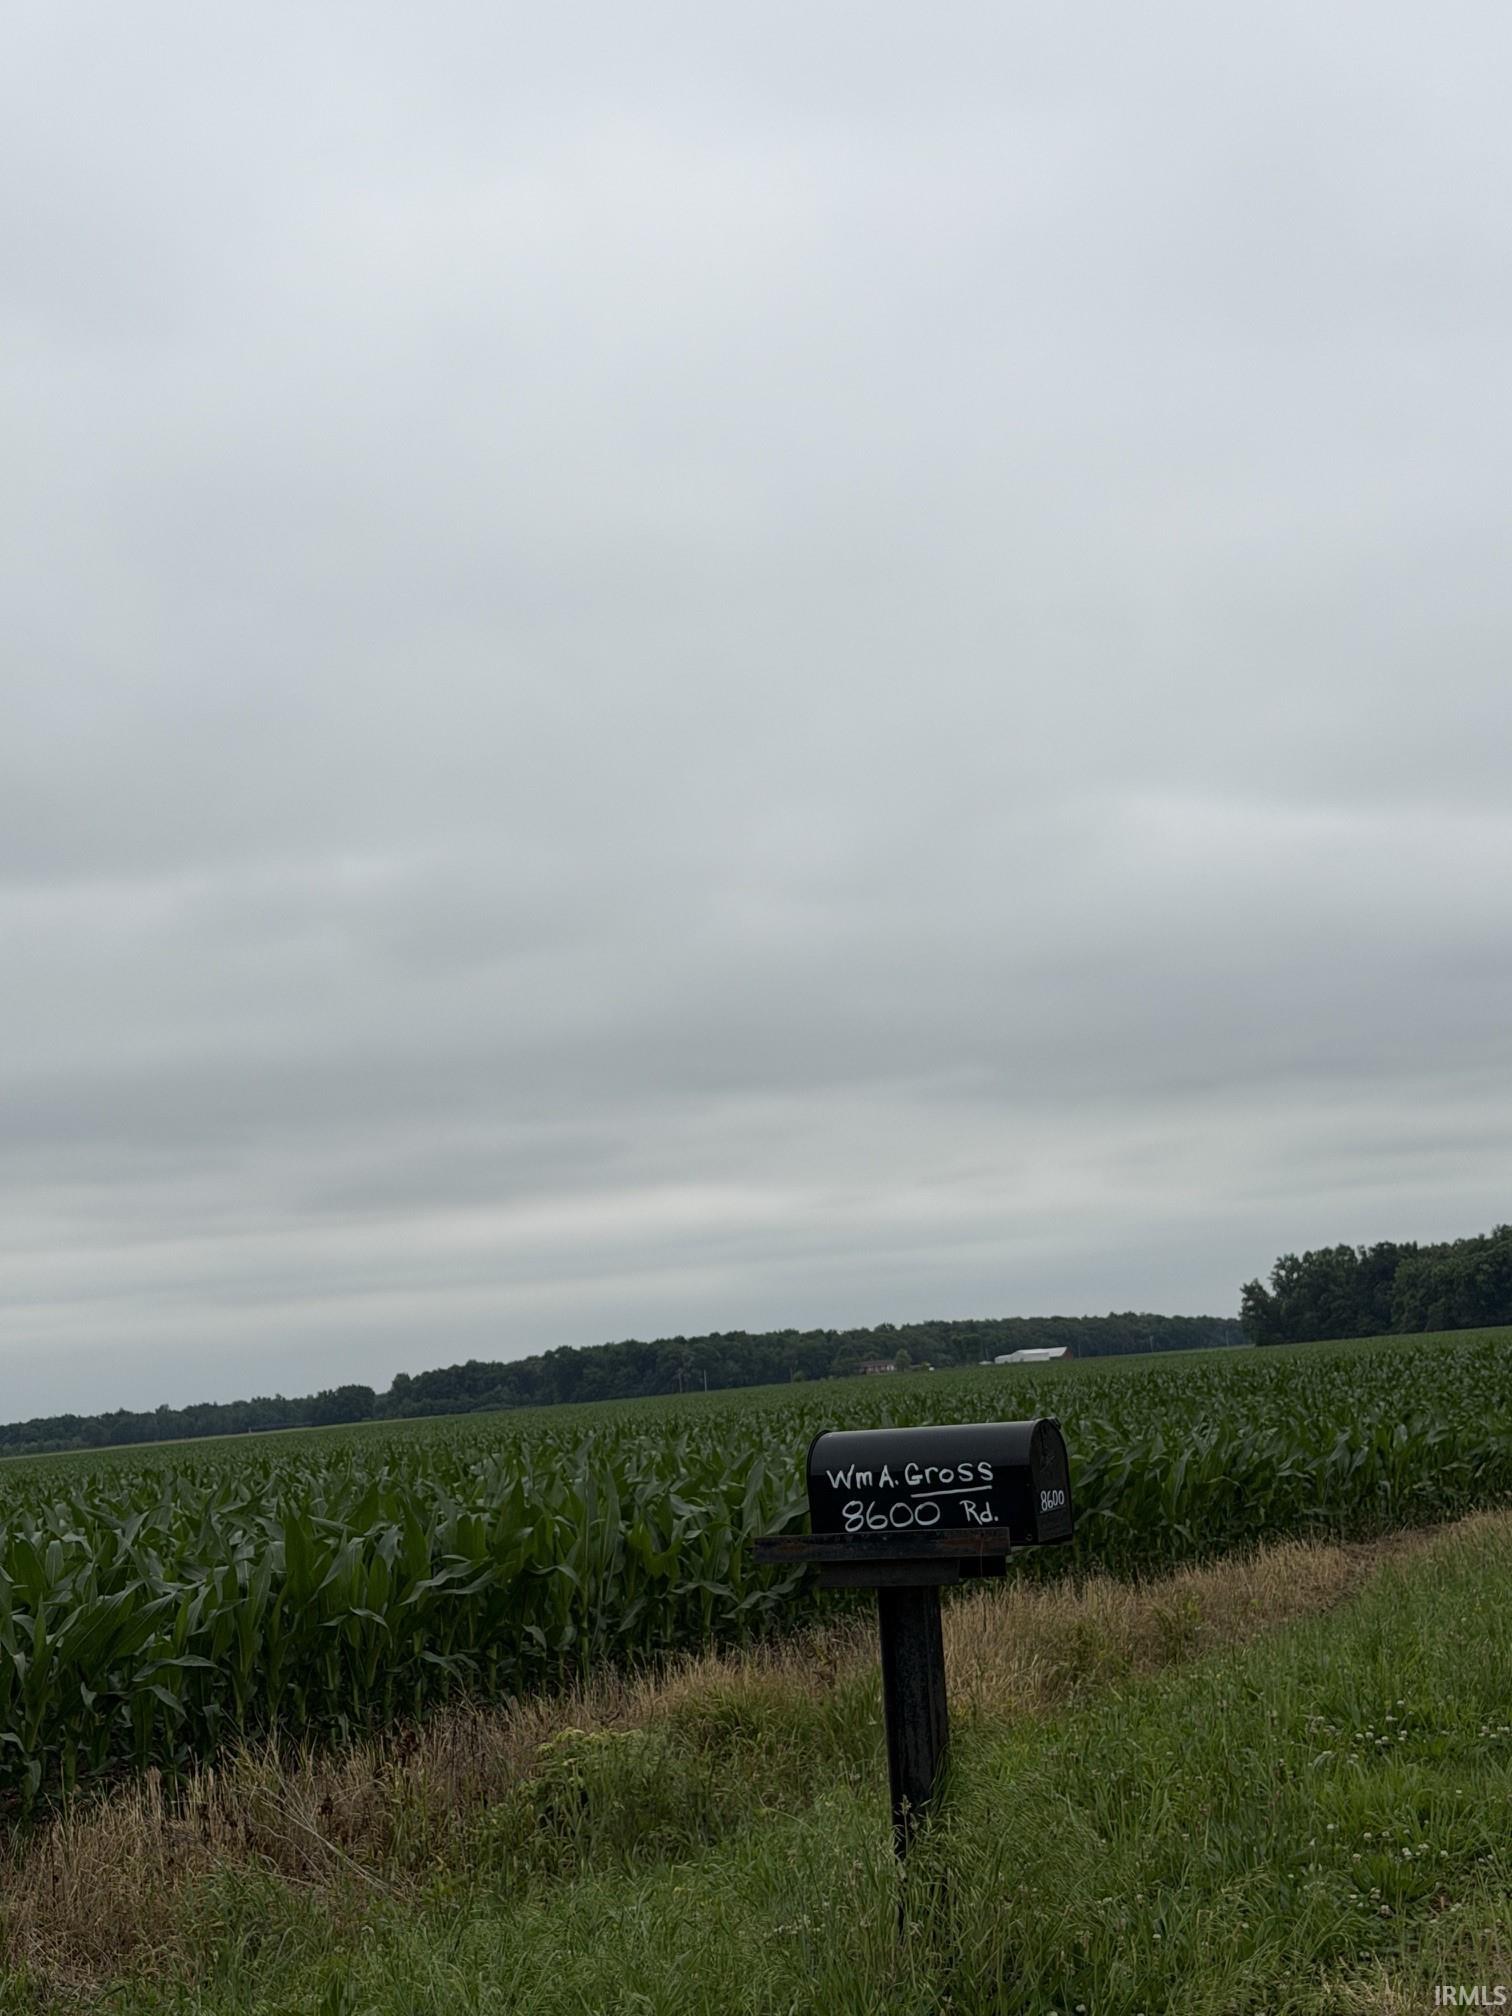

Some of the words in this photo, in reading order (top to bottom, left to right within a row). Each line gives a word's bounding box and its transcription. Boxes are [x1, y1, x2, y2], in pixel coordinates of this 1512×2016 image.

[826, 1464, 873, 1490] Wm
[904, 1461, 994, 1487] Gross
[1040, 1489, 1065, 1512] 8600
[842, 1500, 941, 1533] 8600
[959, 1500, 999, 1526] Rd.
